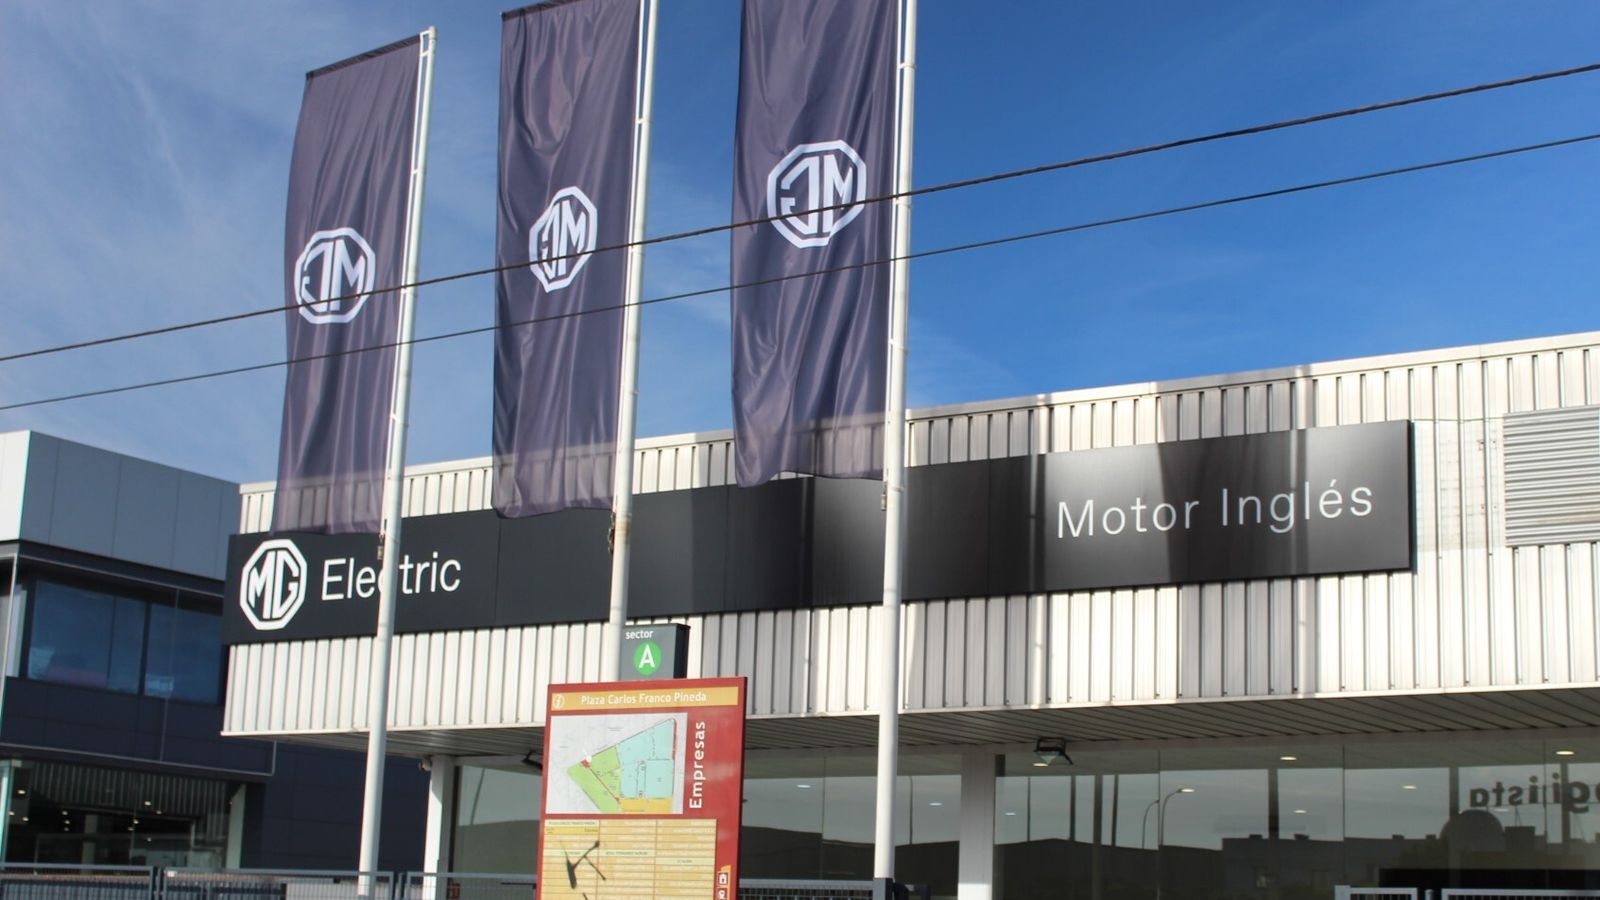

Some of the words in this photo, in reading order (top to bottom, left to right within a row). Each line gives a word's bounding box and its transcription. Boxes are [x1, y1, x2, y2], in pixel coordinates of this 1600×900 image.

[1057, 497, 1200, 538] Motor
[1221, 479, 1373, 534] Inglés
[248, 549, 300, 620] MG
[321, 551, 462, 601] Eletric
[625, 630, 654, 640] sector
[639, 644, 656, 669] A
[581, 695, 605, 705] Plaza
[607, 694, 637, 705] Carlos
[639, 692, 671, 704] Franco
[674, 691, 707, 702] Pineda
[689, 721, 706, 809] Empresas
